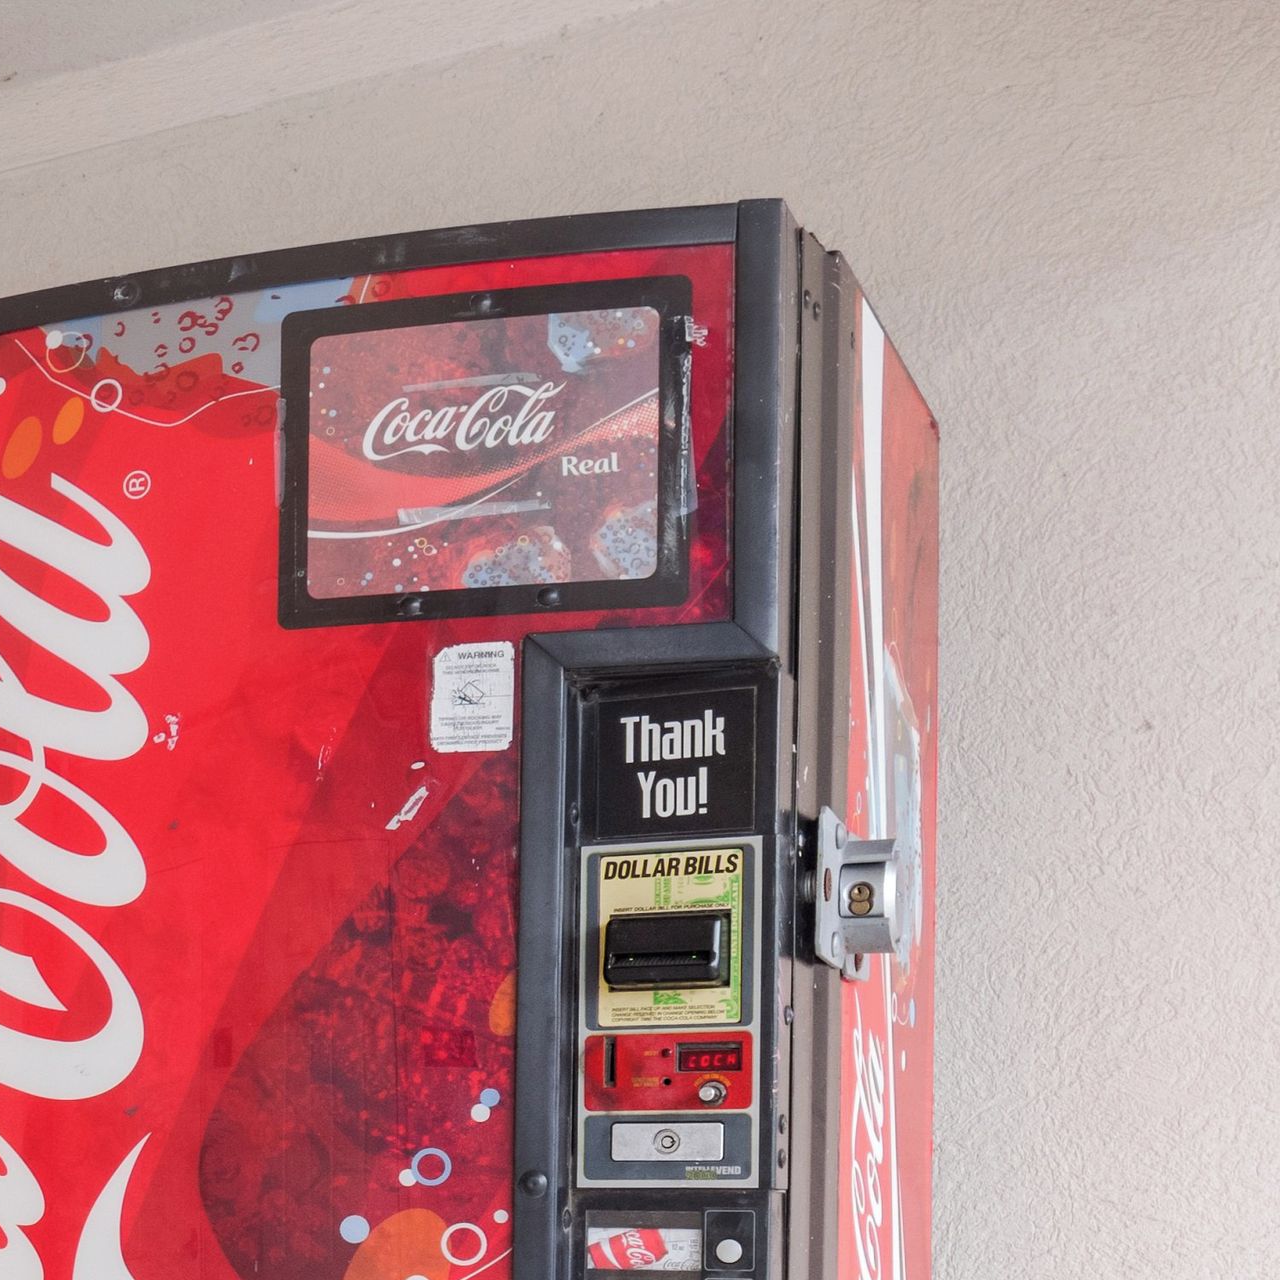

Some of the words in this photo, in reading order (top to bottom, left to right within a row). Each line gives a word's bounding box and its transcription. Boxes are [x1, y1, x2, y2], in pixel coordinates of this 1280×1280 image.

[363, 380, 567, 461] Coca-Cola
[561, 452, 620, 476] Real
[458, 650, 505, 660] WARNING
[620, 709, 727, 764] Thank
[638, 767, 709, 819] You!
[604, 857, 680, 880] DOLLAR
[684, 853, 739, 876] BILLS
